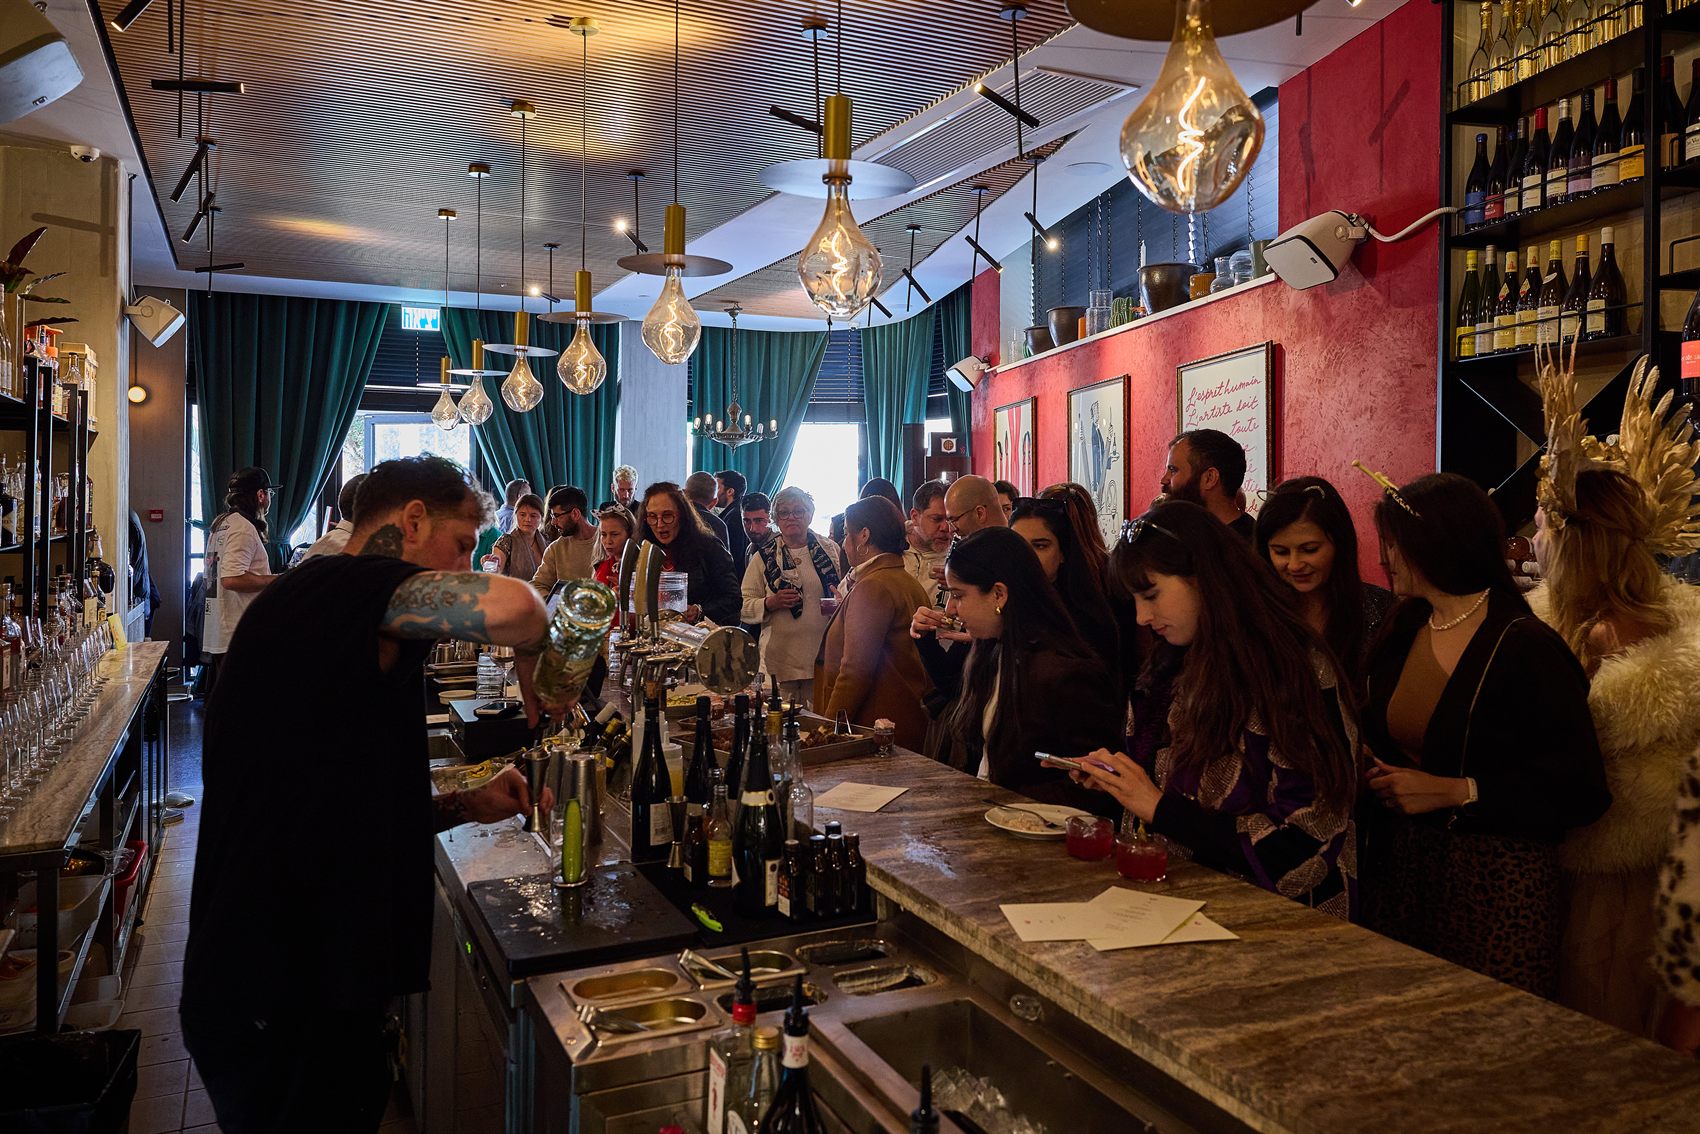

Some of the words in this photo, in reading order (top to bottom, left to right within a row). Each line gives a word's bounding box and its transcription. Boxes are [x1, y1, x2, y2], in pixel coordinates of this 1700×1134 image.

[1186, 381, 1224, 412] L'esprit
[1224, 376, 1262, 395] humain
[1186, 401, 1233, 428] L'artiste
[1236, 396, 1259, 412] doit
[1229, 417, 1259, 437] toute
